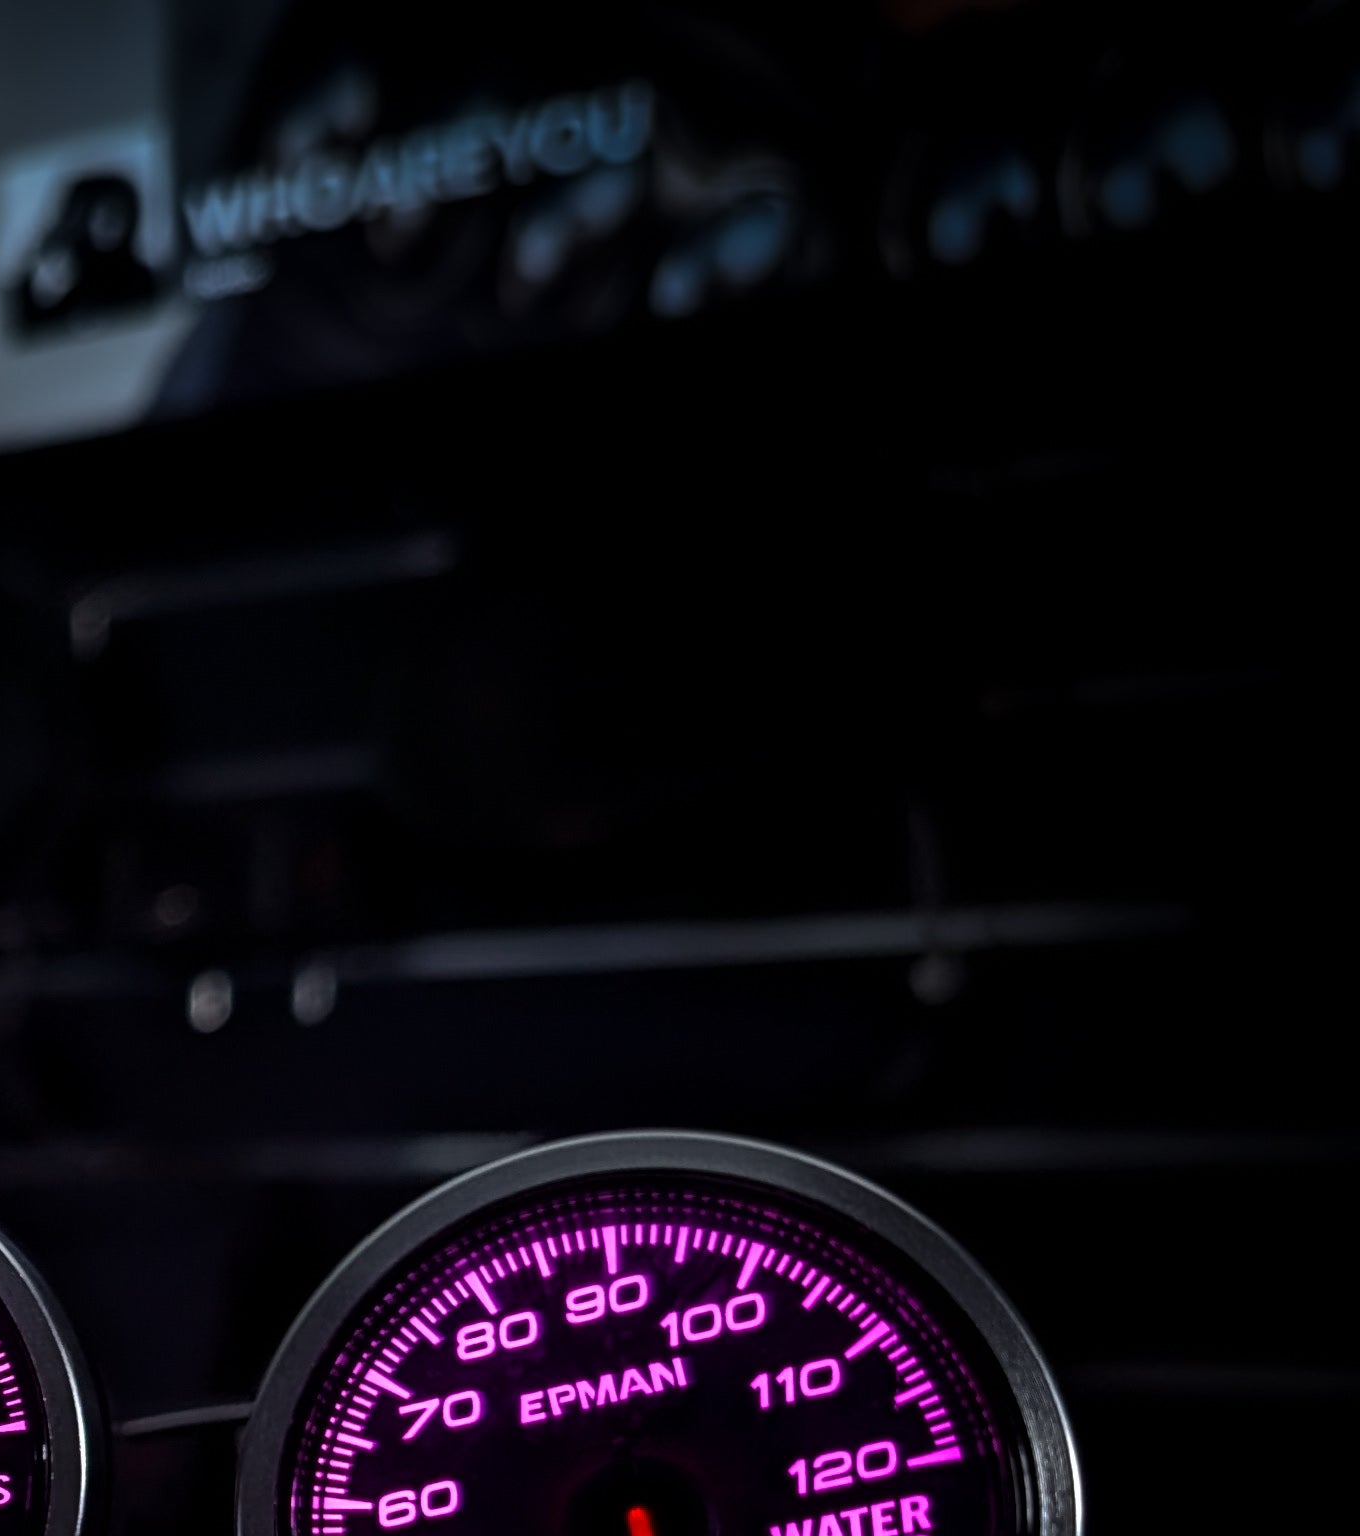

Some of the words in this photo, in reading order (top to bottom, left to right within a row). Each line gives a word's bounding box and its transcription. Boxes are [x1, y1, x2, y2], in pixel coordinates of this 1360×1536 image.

[564, 1274, 651, 1325] 90
[659, 1293, 767, 1349] 100
[455, 1310, 539, 1361] 80
[519, 1357, 689, 1425] EPMAN
[749, 1358, 842, 1410] 110
[397, 1389, 482, 1444] 70
[787, 1440, 900, 1497] 120
[377, 1480, 460, 1528] 60
